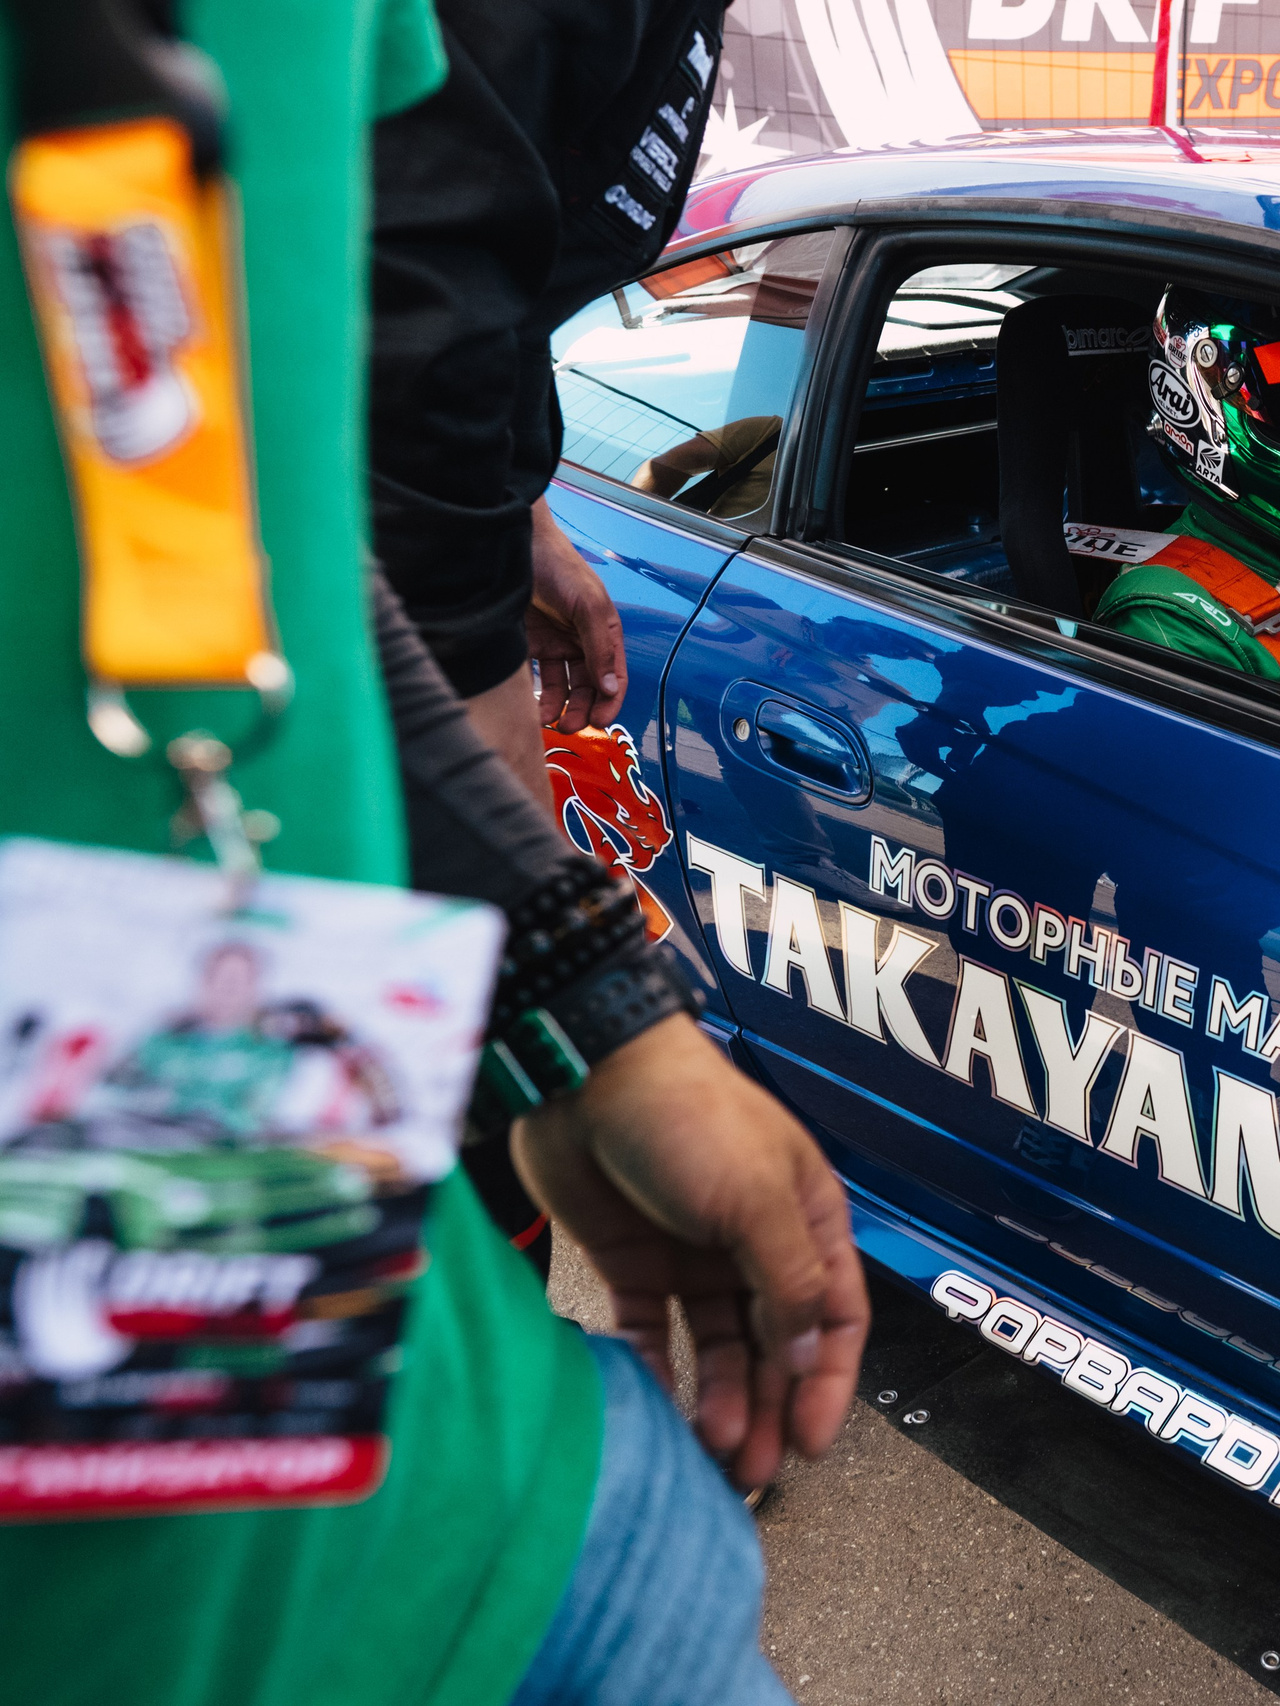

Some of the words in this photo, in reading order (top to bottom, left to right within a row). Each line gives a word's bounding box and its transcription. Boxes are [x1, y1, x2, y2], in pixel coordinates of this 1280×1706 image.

[1168, 343, 1187, 362] BRIDE
[1150, 370, 1193, 416] Arai
[1196, 466, 1221, 485] ARTA
[1064, 532, 1146, 558] IDE
[869, 834, 1200, 1026] МОТОРНЫЕ
